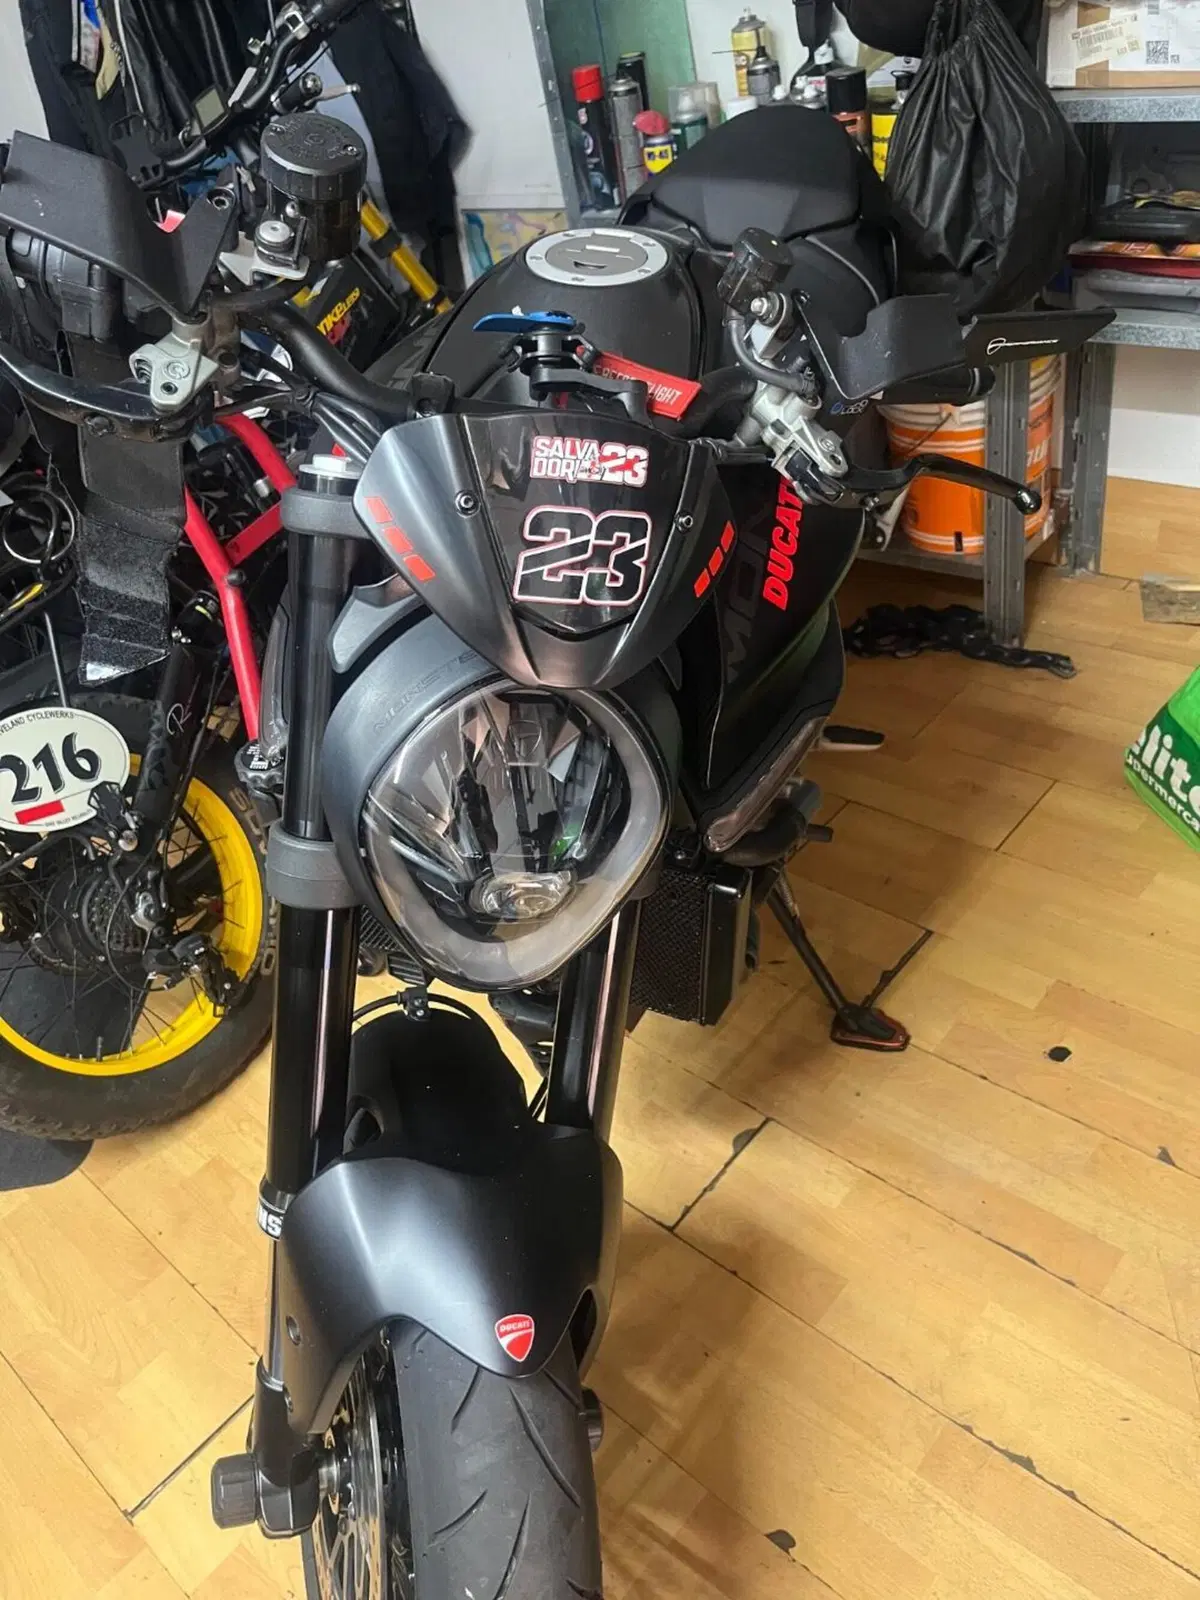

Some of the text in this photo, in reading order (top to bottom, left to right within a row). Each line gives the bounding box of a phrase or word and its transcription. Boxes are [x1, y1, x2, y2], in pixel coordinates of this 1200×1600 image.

[534, 437, 600, 460] SALVA
[599, 442, 649, 488] 23
[512, 504, 652, 607] 23
[26, 710, 76, 722] CYCLEWERKS
[0, 731, 102, 805] 216
[499, 1319, 531, 1333] DUCATI
